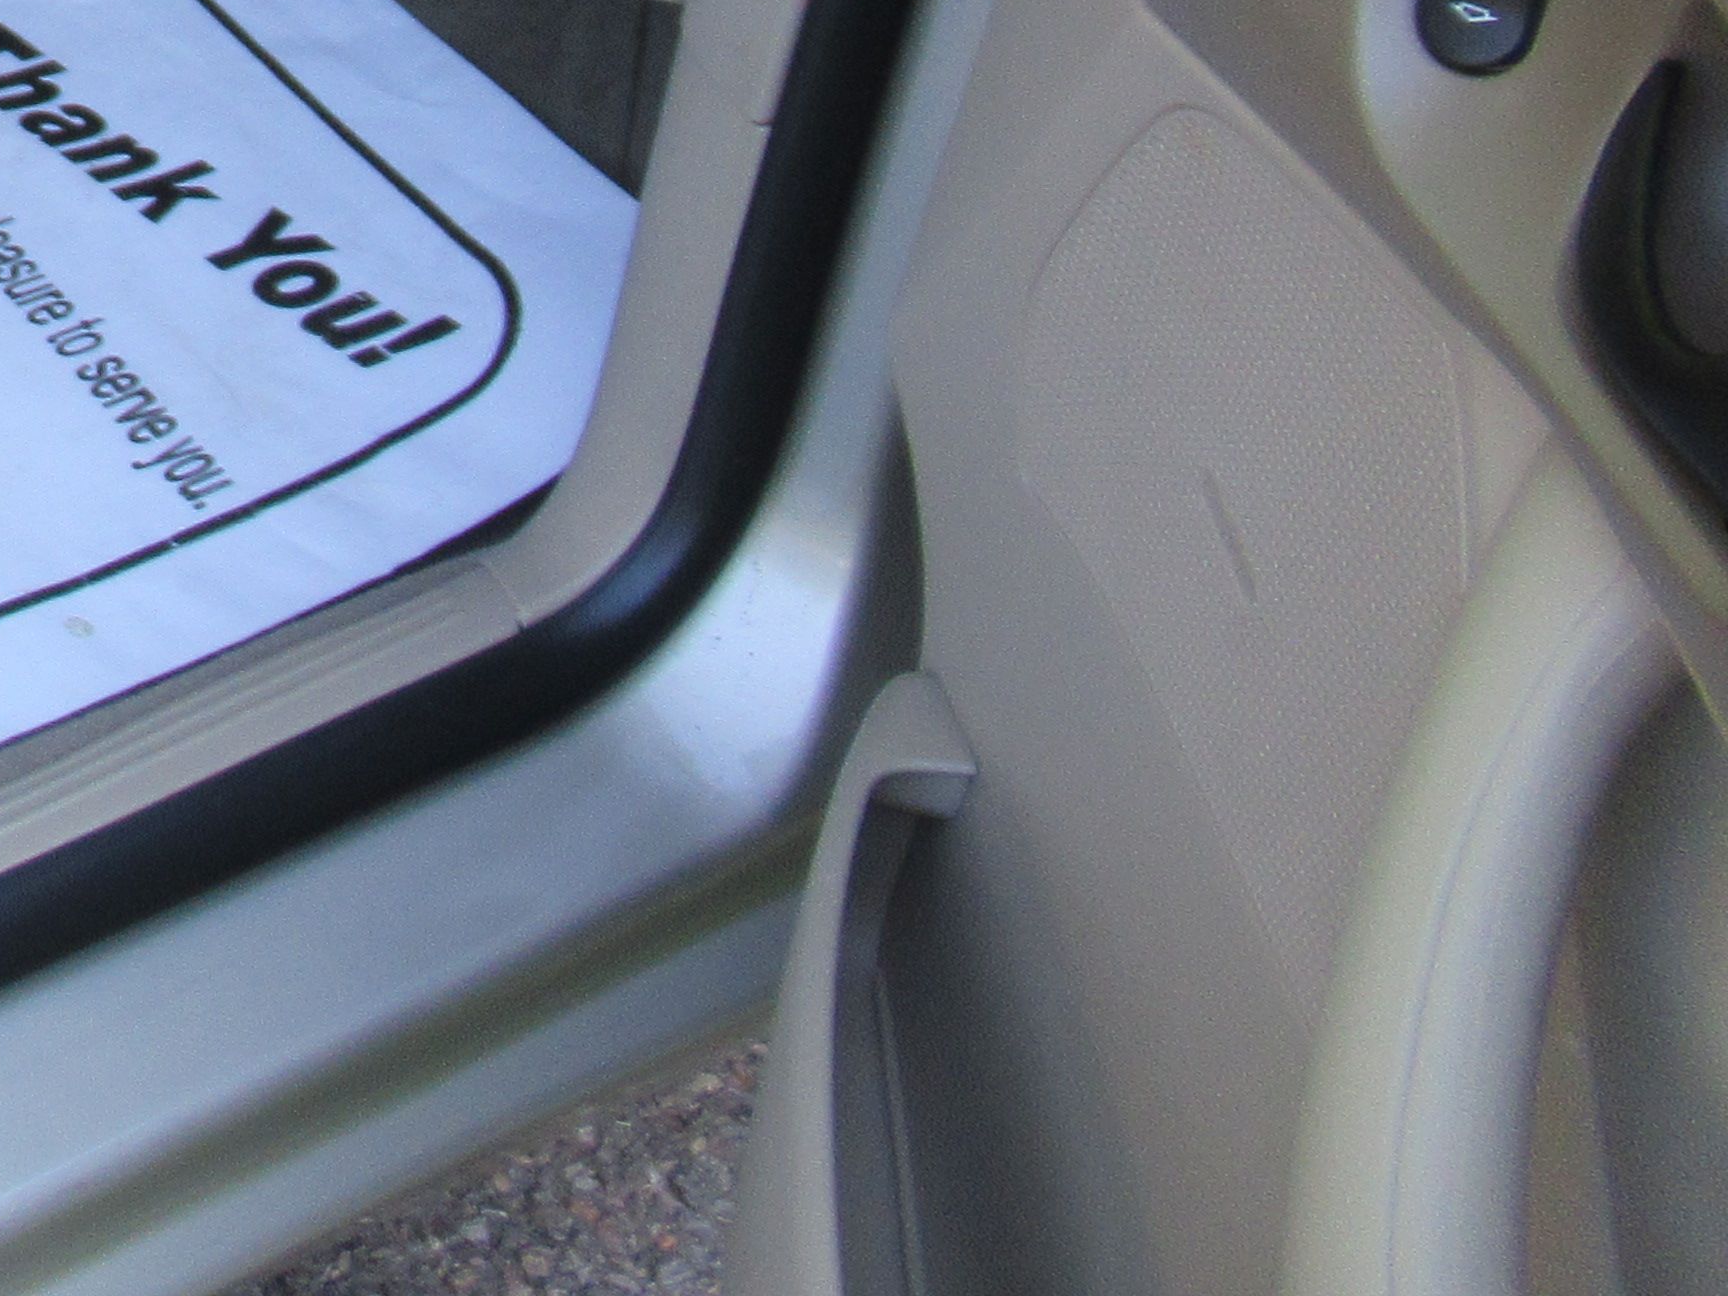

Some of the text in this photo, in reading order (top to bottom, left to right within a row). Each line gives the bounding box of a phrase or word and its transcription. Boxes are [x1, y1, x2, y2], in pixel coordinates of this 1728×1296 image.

[207, 207, 461, 368] You!
[47, 316, 105, 356] to
[76, 354, 179, 443] serve
[131, 436, 234, 510] you.
